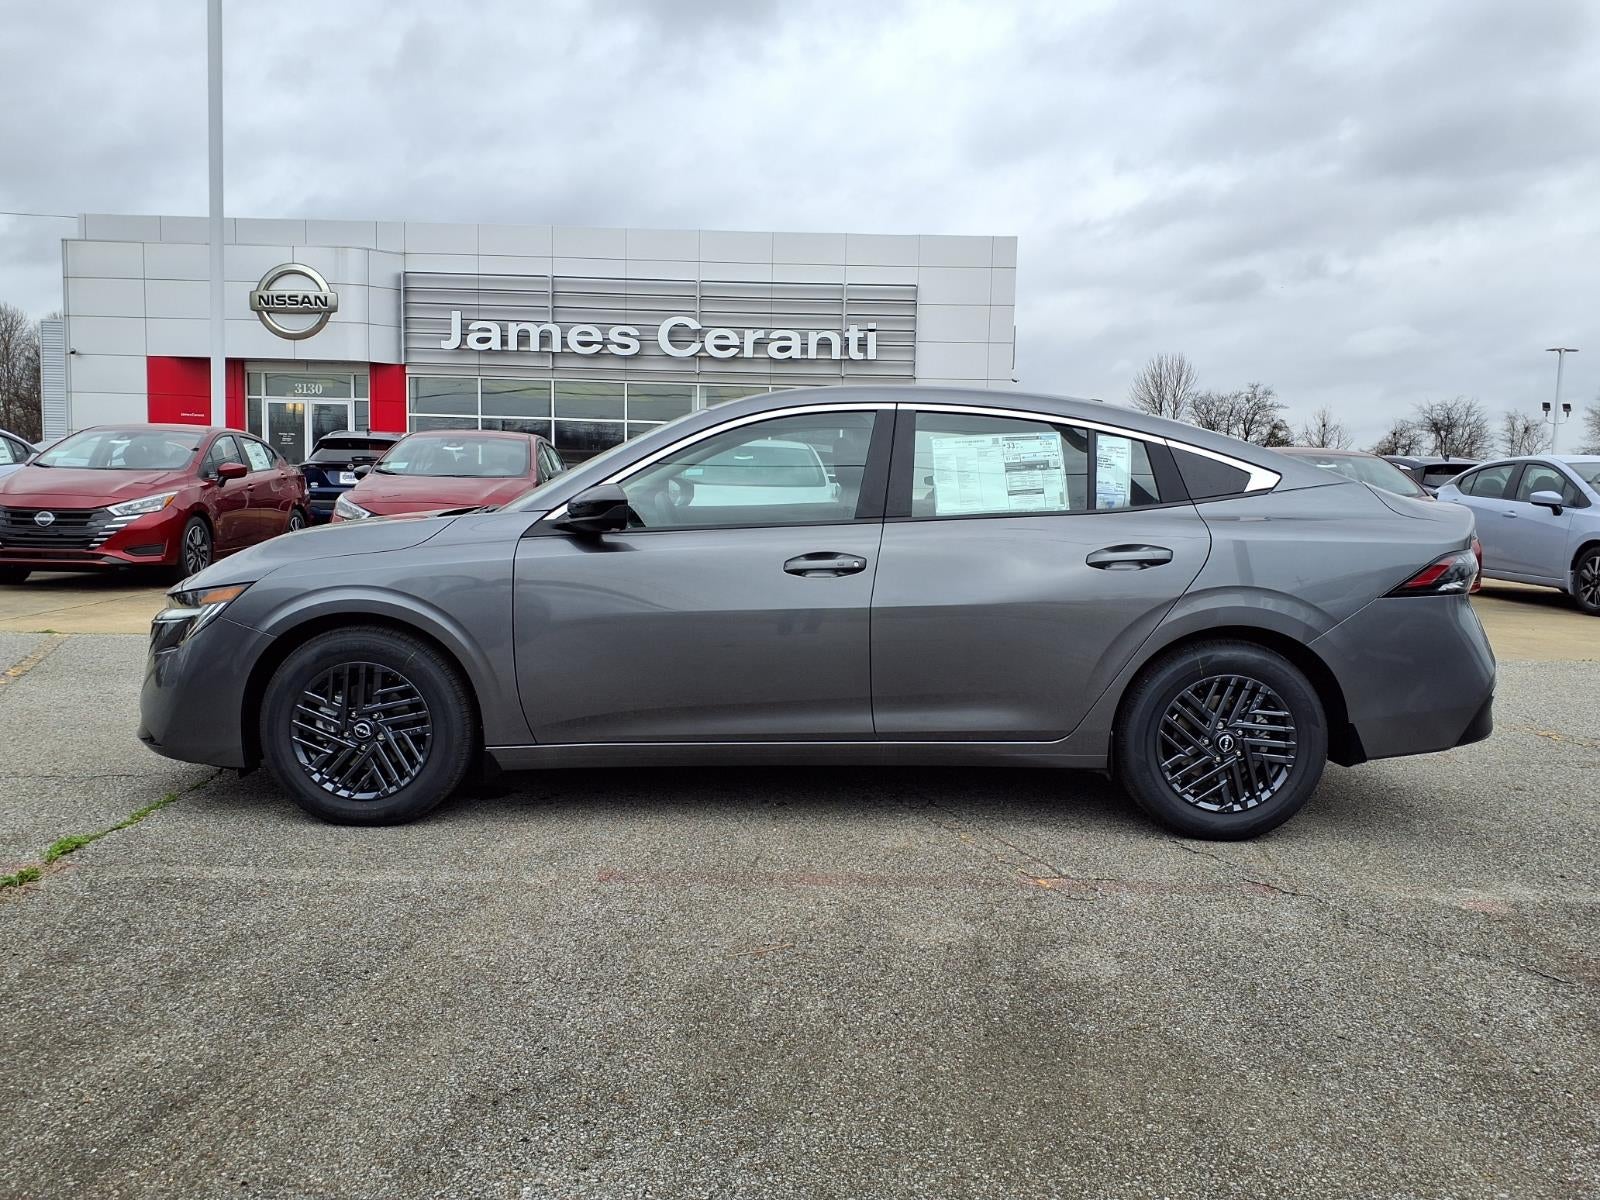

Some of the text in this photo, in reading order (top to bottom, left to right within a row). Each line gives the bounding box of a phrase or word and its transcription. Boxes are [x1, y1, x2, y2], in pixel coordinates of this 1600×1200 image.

[258, 294, 328, 307] NISSAN
[441, 310, 877, 360] James Ceranti
[294, 383, 323, 395] 3130
